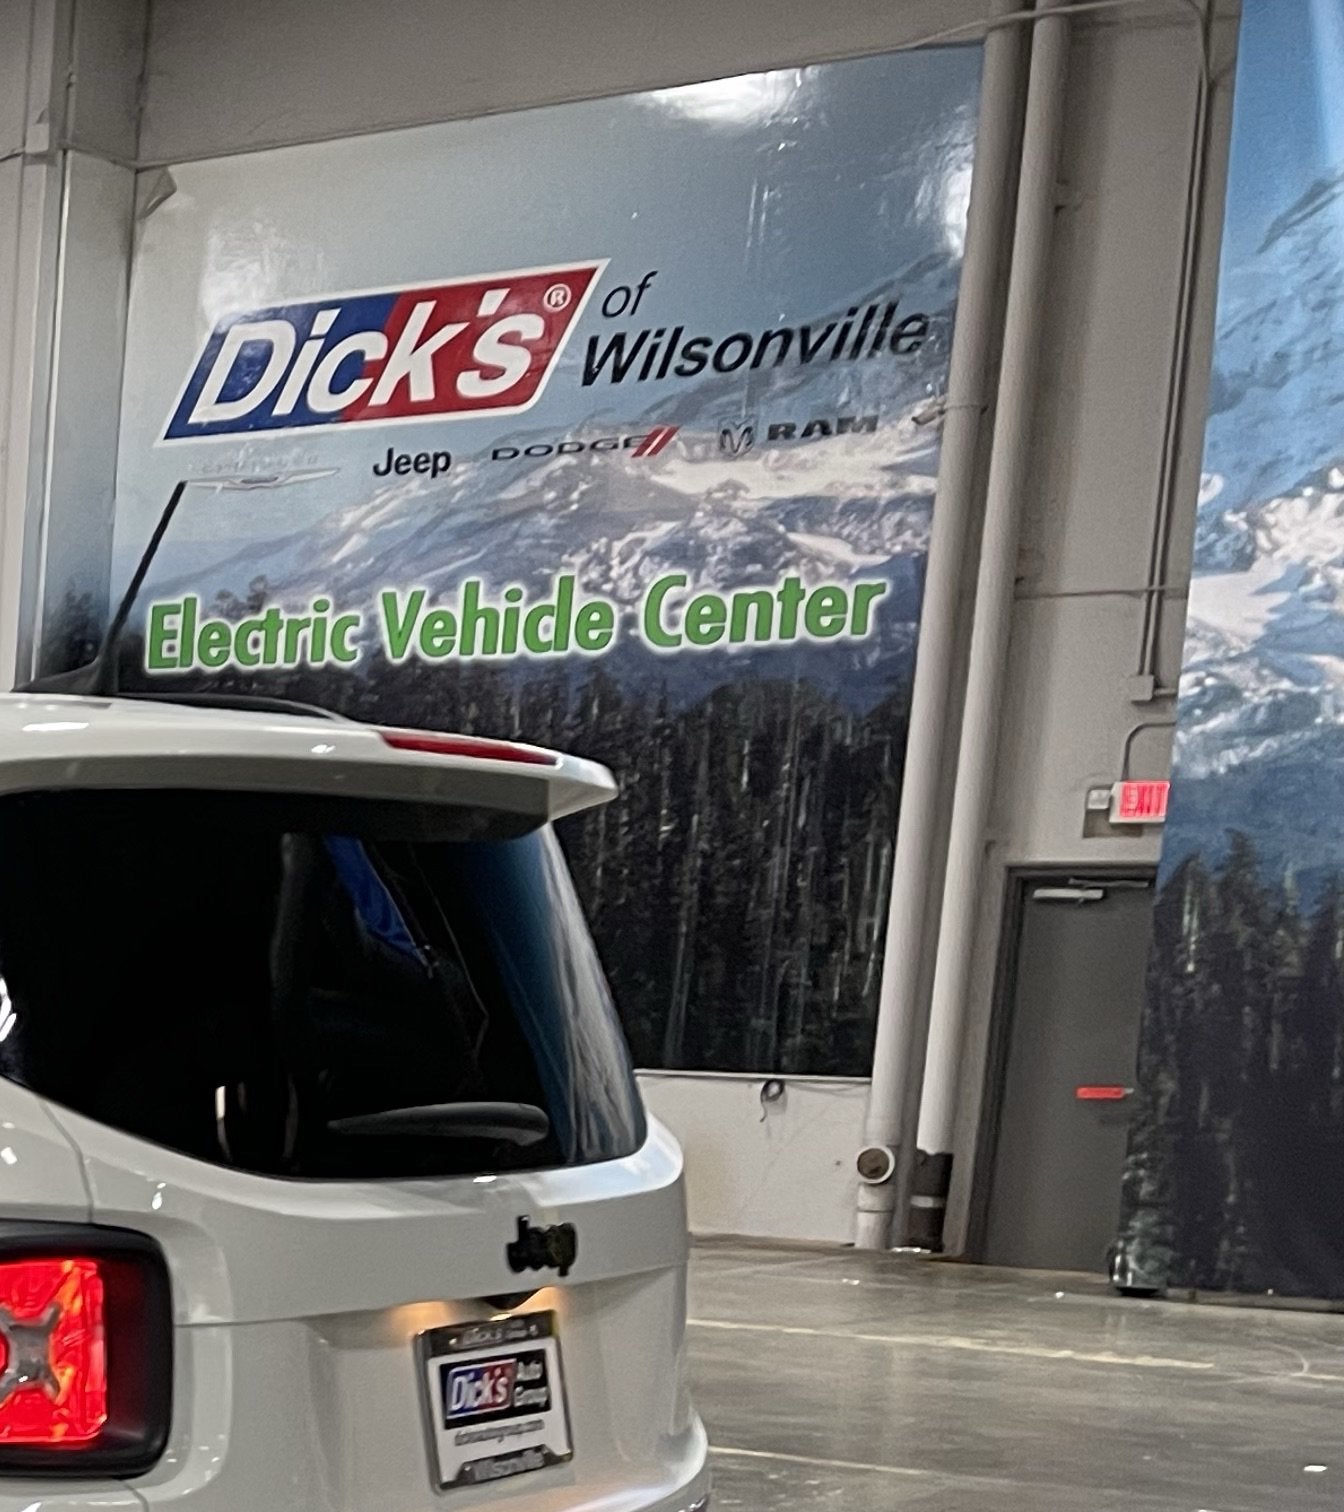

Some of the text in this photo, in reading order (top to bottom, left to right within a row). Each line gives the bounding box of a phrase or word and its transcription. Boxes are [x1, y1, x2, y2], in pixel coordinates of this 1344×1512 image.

[602, 271, 658, 317] of
[188, 288, 545, 424] Dick's
[581, 300, 929, 387] Wilsonville
[491, 434, 652, 461] DODGE
[767, 415, 879, 441] RAM
[373, 448, 451, 478] Jeep
[148, 575, 887, 669] Electric Vehicle Center
[450, 1367, 509, 1411] Dick's
